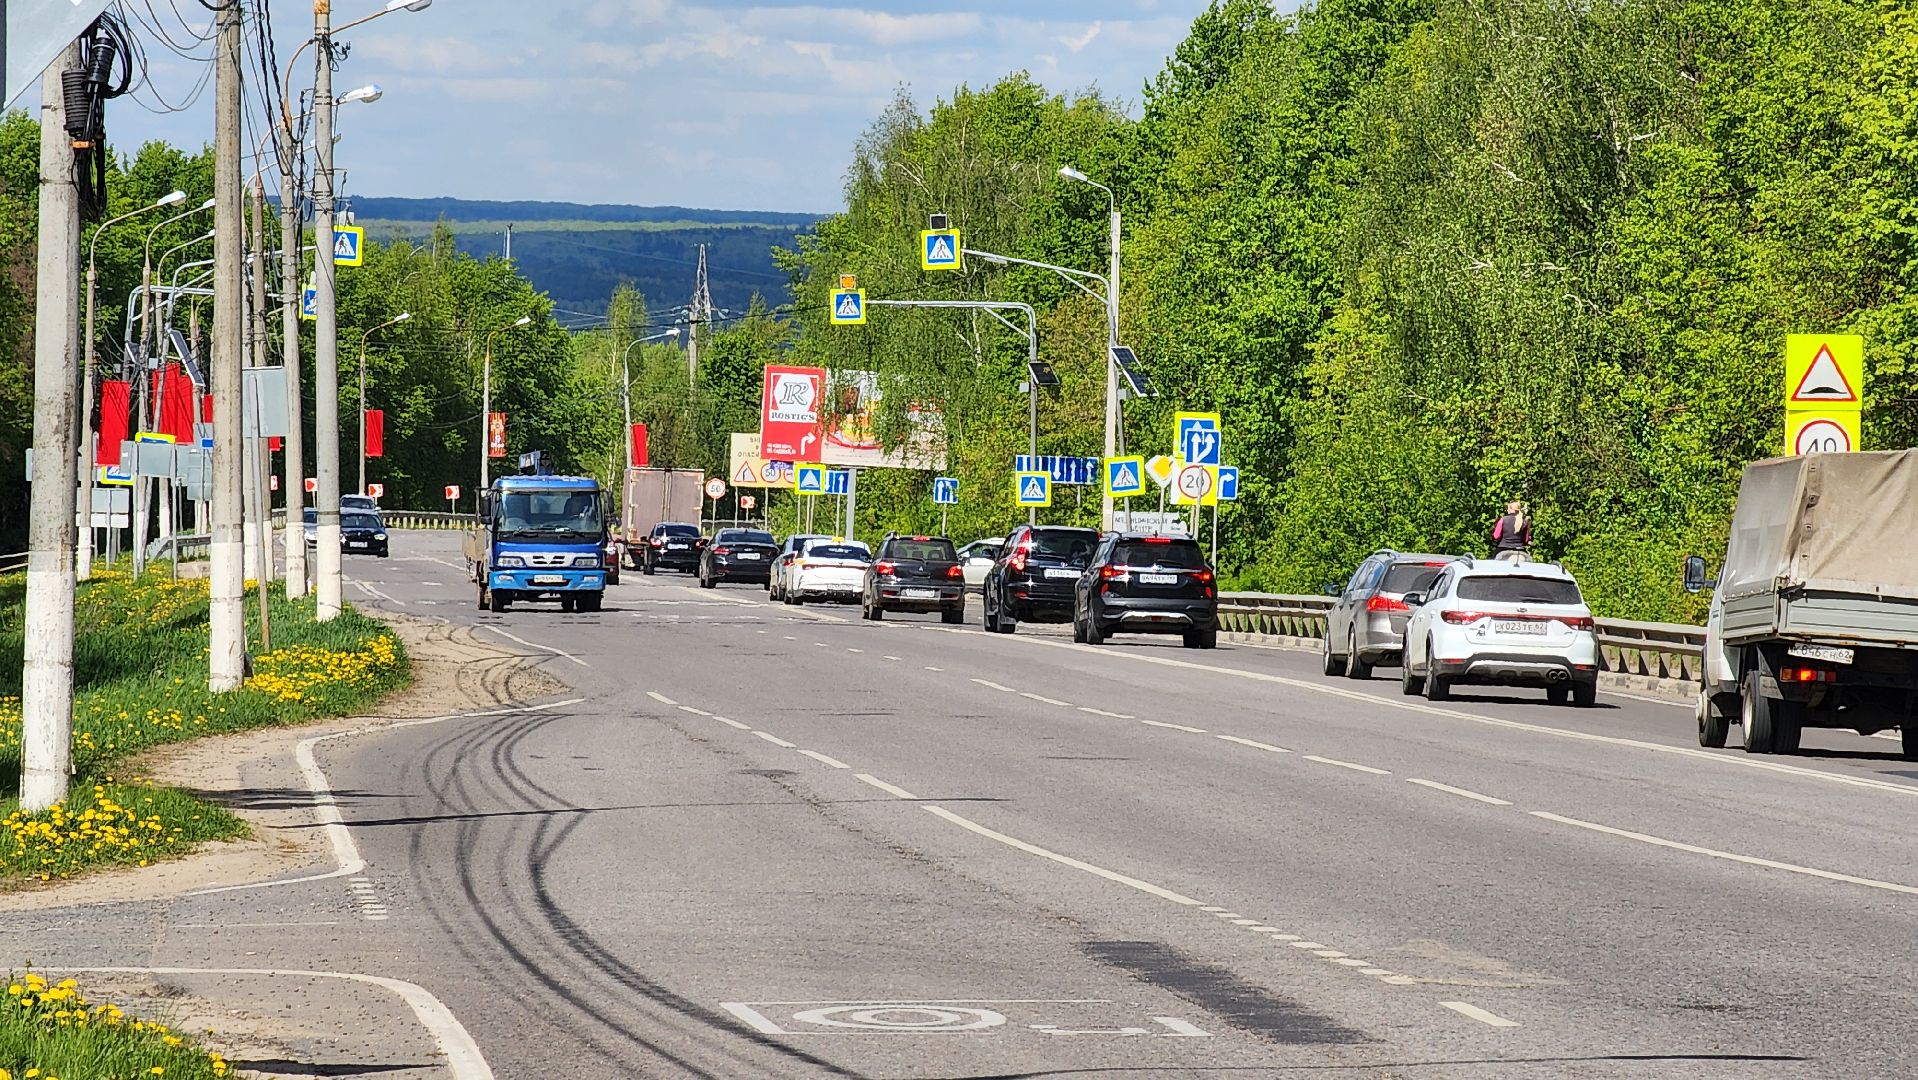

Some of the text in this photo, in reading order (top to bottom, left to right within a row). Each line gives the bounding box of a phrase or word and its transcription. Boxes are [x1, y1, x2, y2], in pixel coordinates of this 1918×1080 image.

[771, 412, 816, 422] ROSTIC'S
[765, 469, 776, 478] 50
[1186, 475, 1205, 489] 20
[711, 485, 721, 493] 50
